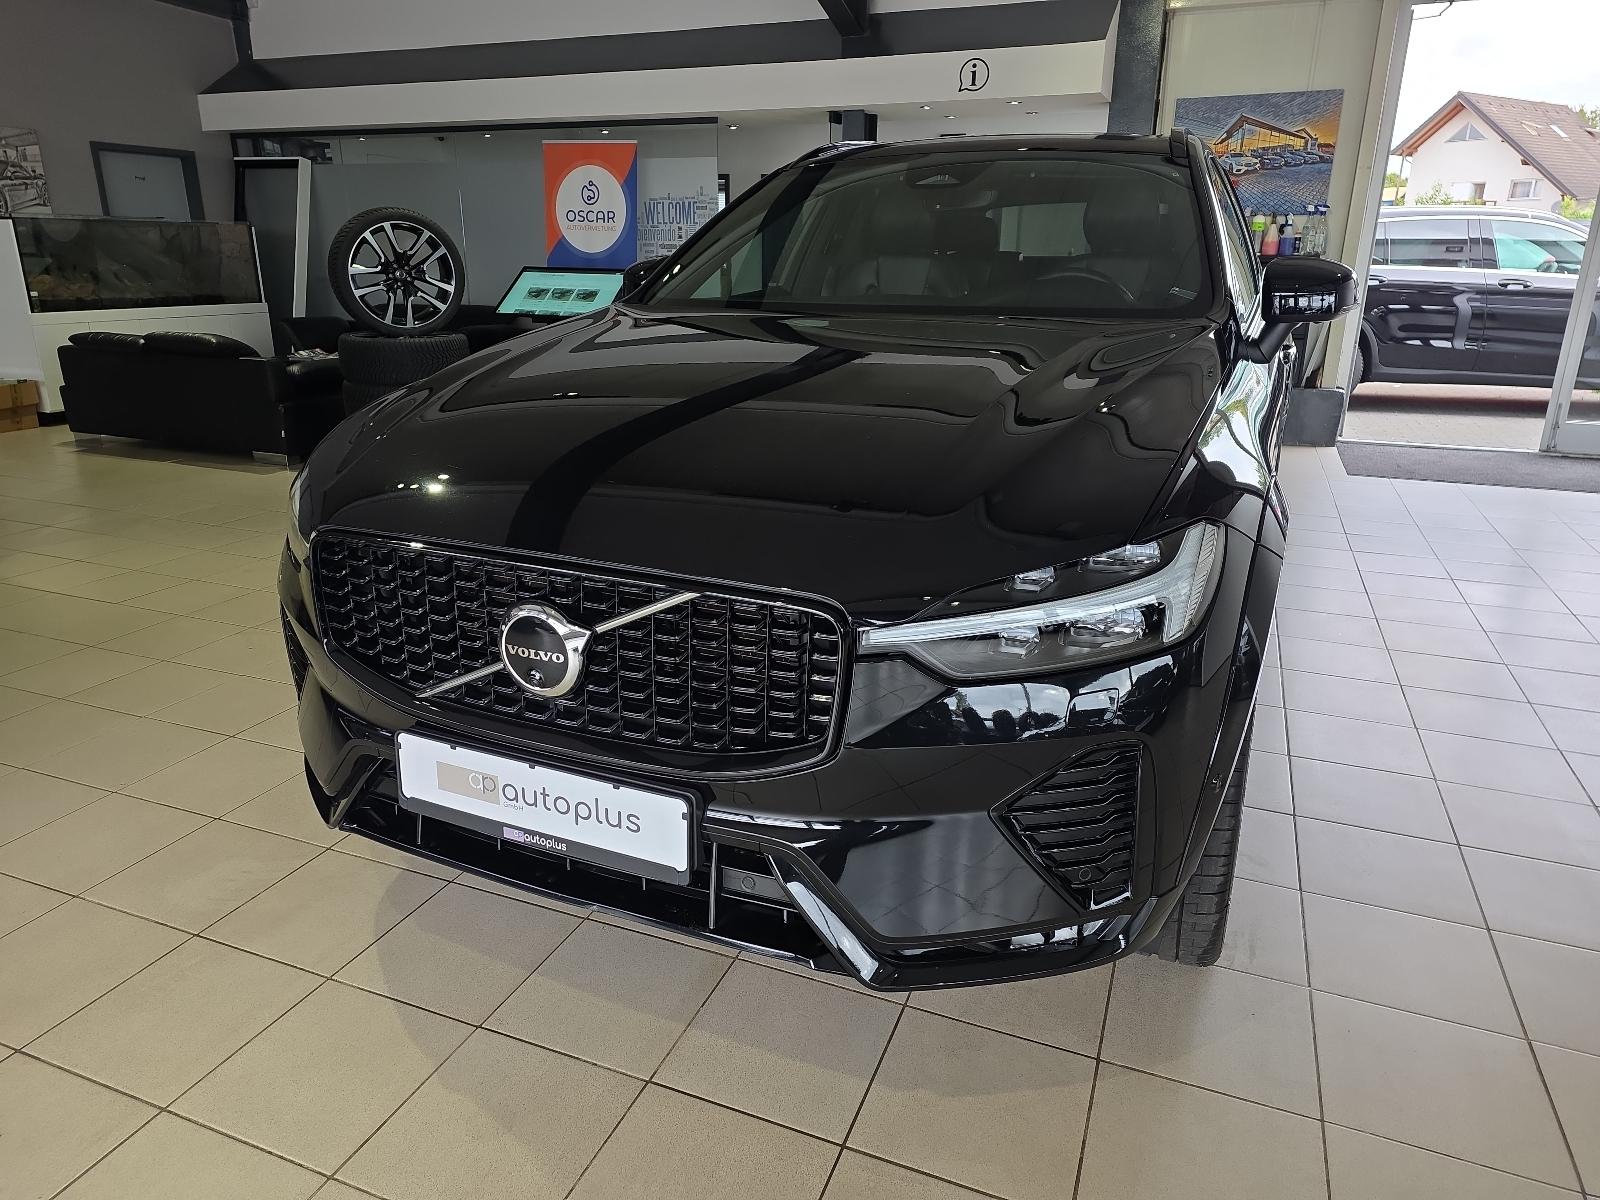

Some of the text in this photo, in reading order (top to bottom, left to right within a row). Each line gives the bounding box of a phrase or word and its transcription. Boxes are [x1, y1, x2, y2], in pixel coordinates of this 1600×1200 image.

[566, 210, 616, 224] OSCAR
[644, 201, 698, 225] WELCOME
[566, 224, 616, 232] AUTOVERMIETUNG
[506, 644, 565, 663] VOLVO
[502, 783, 641, 833] autoplus
[503, 801, 524, 812] GmbH
[524, 834, 567, 851] autoplus
